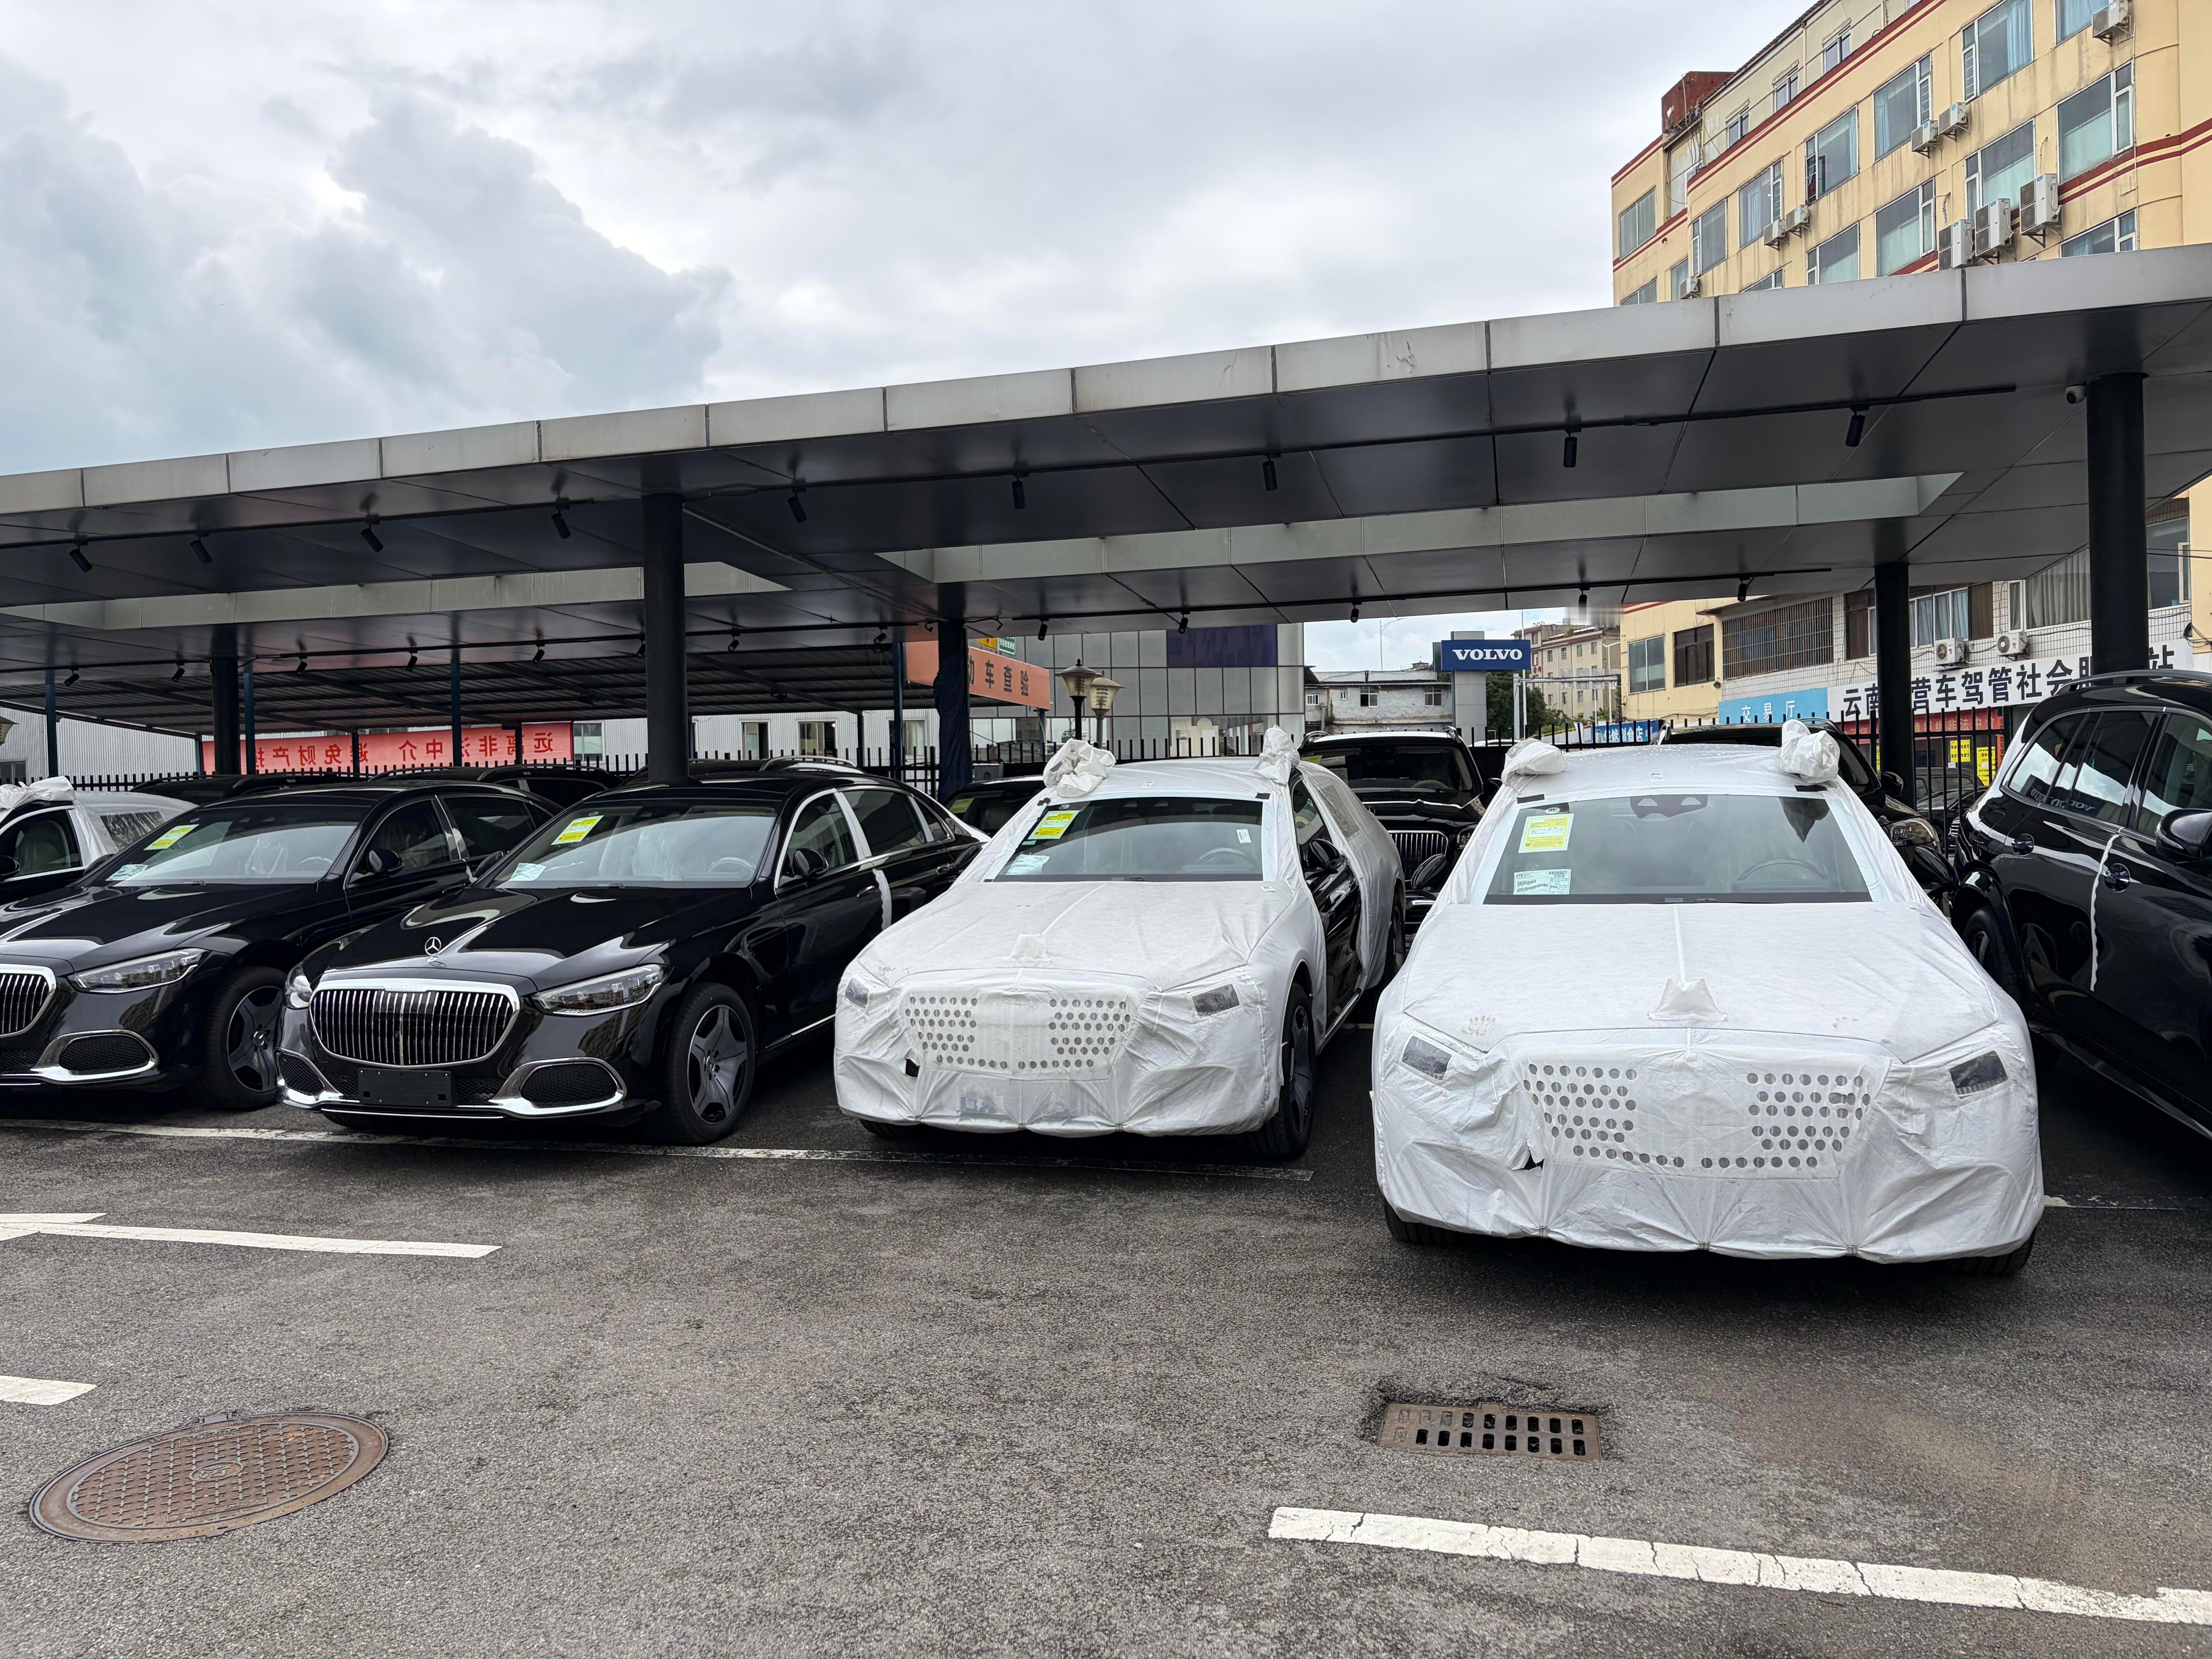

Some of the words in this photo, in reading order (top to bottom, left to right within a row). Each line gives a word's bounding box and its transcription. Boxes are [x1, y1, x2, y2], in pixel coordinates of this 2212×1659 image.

[1452, 649, 1523, 660] VOLVO
[1844, 645, 2174, 716] 云南营车驾管社会站
[1742, 700, 1795, 723] 交易厅
